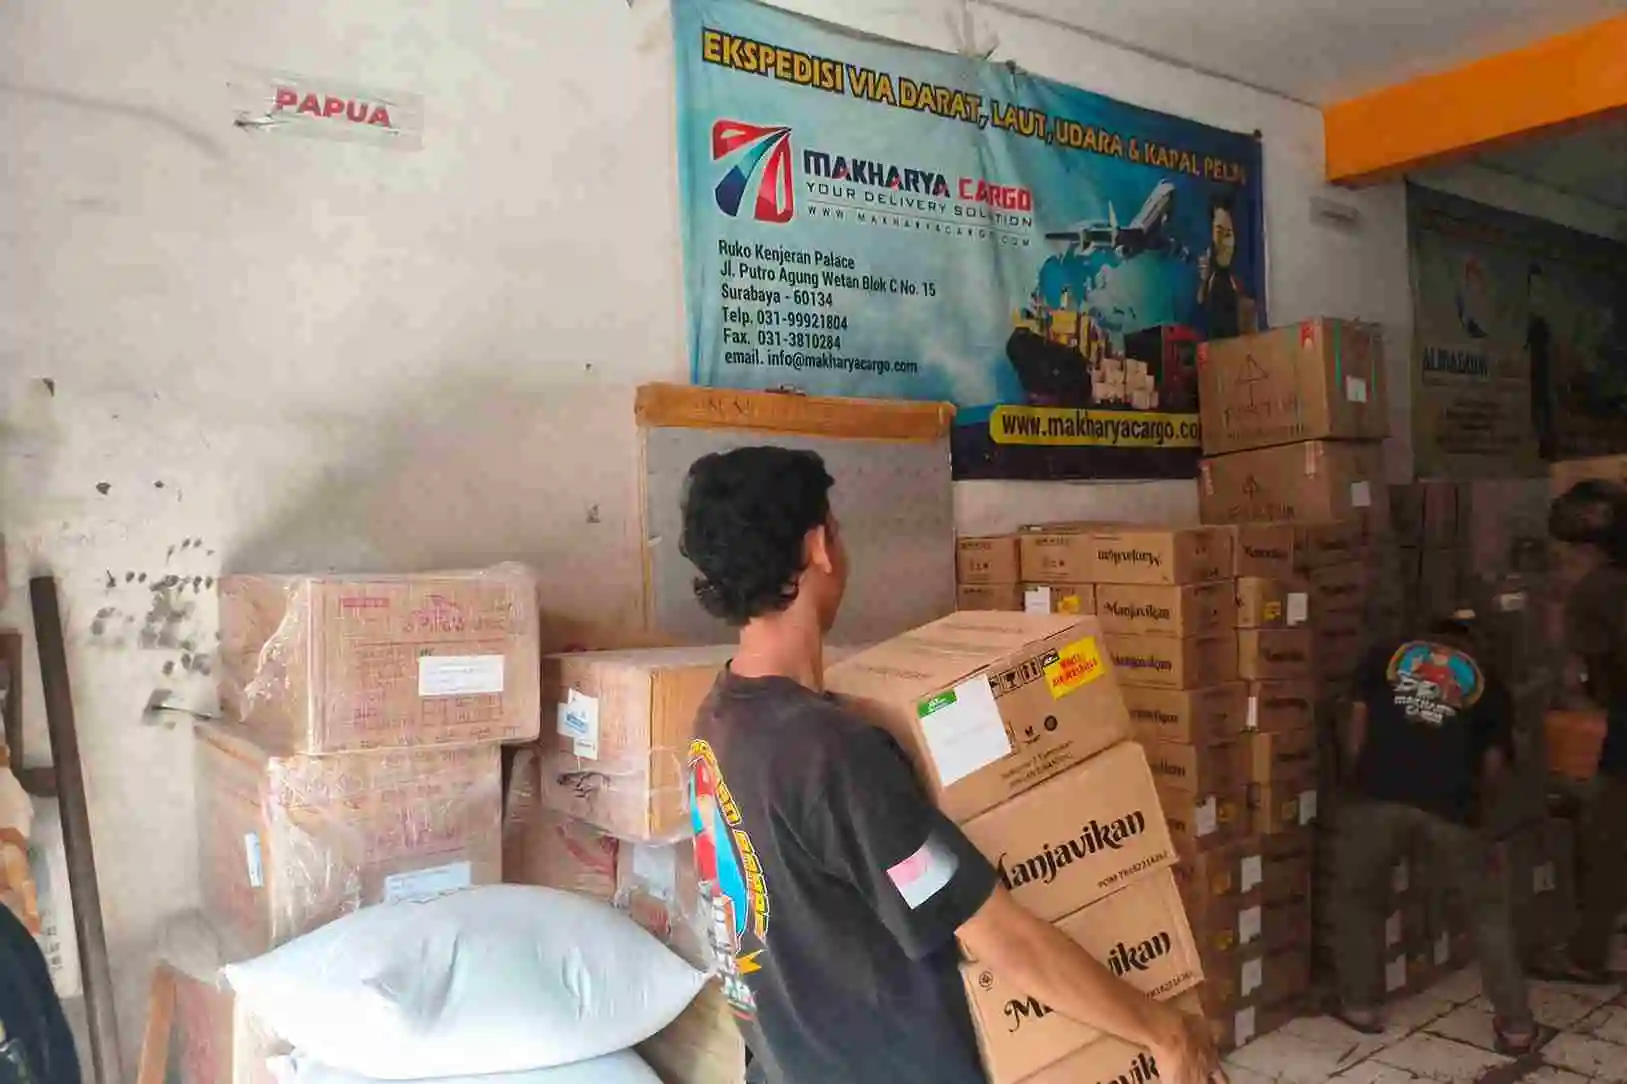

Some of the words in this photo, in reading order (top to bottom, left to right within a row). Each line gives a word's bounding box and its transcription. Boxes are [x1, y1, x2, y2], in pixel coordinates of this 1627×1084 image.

[273, 87, 393, 128] PAPUA
[702, 28, 845, 94] EKSPEDISI
[847, 64, 898, 106] VIA
[899, 77, 988, 128] DARAT,
[990, 100, 1053, 144] LAUT,
[1055, 119, 1124, 158] UDARA
[1127, 141, 1140, 161] &
[1144, 142, 1199, 175] KAPAL
[803, 150, 950, 198] MAKHARYA
[959, 177, 1033, 212] CARGO
[807, 183, 857, 201] YOUR
[864, 190, 946, 213] DELIVERY
[718, 240, 751, 259] Ruko
[755, 244, 811, 266] Kenjeran
[814, 250, 855, 270] Palace
[720, 263, 736, 279] Jl.
[739, 263, 775, 281] Putro
[779, 268, 819, 288] Agung
[822, 271, 860, 290] Wetan
[863, 276, 887, 293] Blok
[889, 280, 898, 293] C
[900, 281, 919, 295] No.
[923, 282, 936, 297] 15
[721, 284, 781, 306] Surabaya
[793, 290, 833, 306] 60134
[722, 307, 753, 327] Telp.
[757, 310, 848, 330] 031-99921804
[723, 328, 751, 346] Fax.
[758, 330, 841, 350] 031-3810284
[725, 350, 764, 366] email.
[767, 350, 918, 375] info@makharyacargo.com
[1001, 408, 1201, 445] www.makharyacargo.co
[1108, 932, 1170, 977] ikan
[1004, 996, 1054, 1032] M
